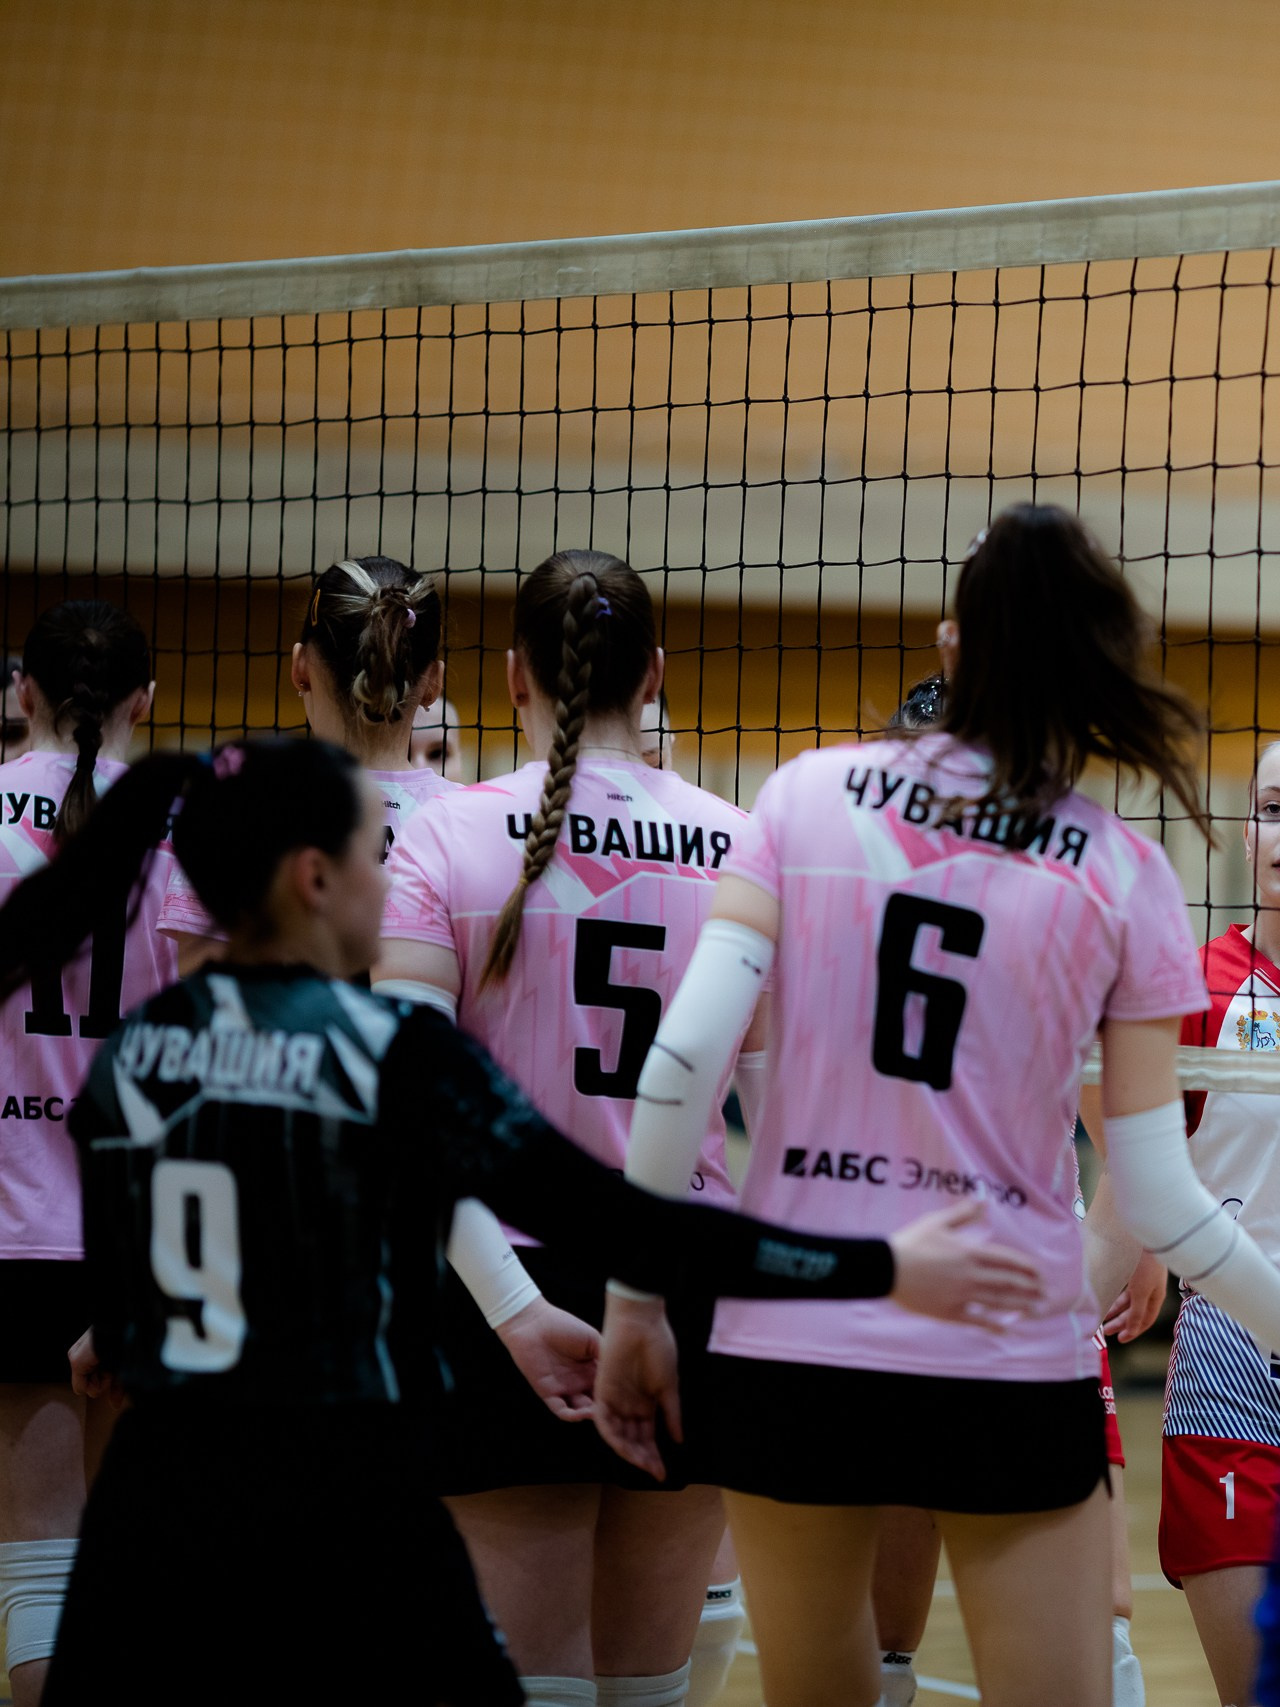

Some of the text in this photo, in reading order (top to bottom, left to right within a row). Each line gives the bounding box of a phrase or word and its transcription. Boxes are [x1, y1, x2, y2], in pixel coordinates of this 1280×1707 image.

[606, 792, 634, 802] Hitch
[507, 812, 732, 869] ЧВАШИЯ
[574, 918, 666, 1100] 5
[872, 892, 986, 1092] 6
[119, 1023, 324, 1094] ЧУВАШИЯ
[811, 1150, 889, 1186] АБС
[151, 1158, 247, 1374] 9
[1219, 1471, 1235, 1520] 1
